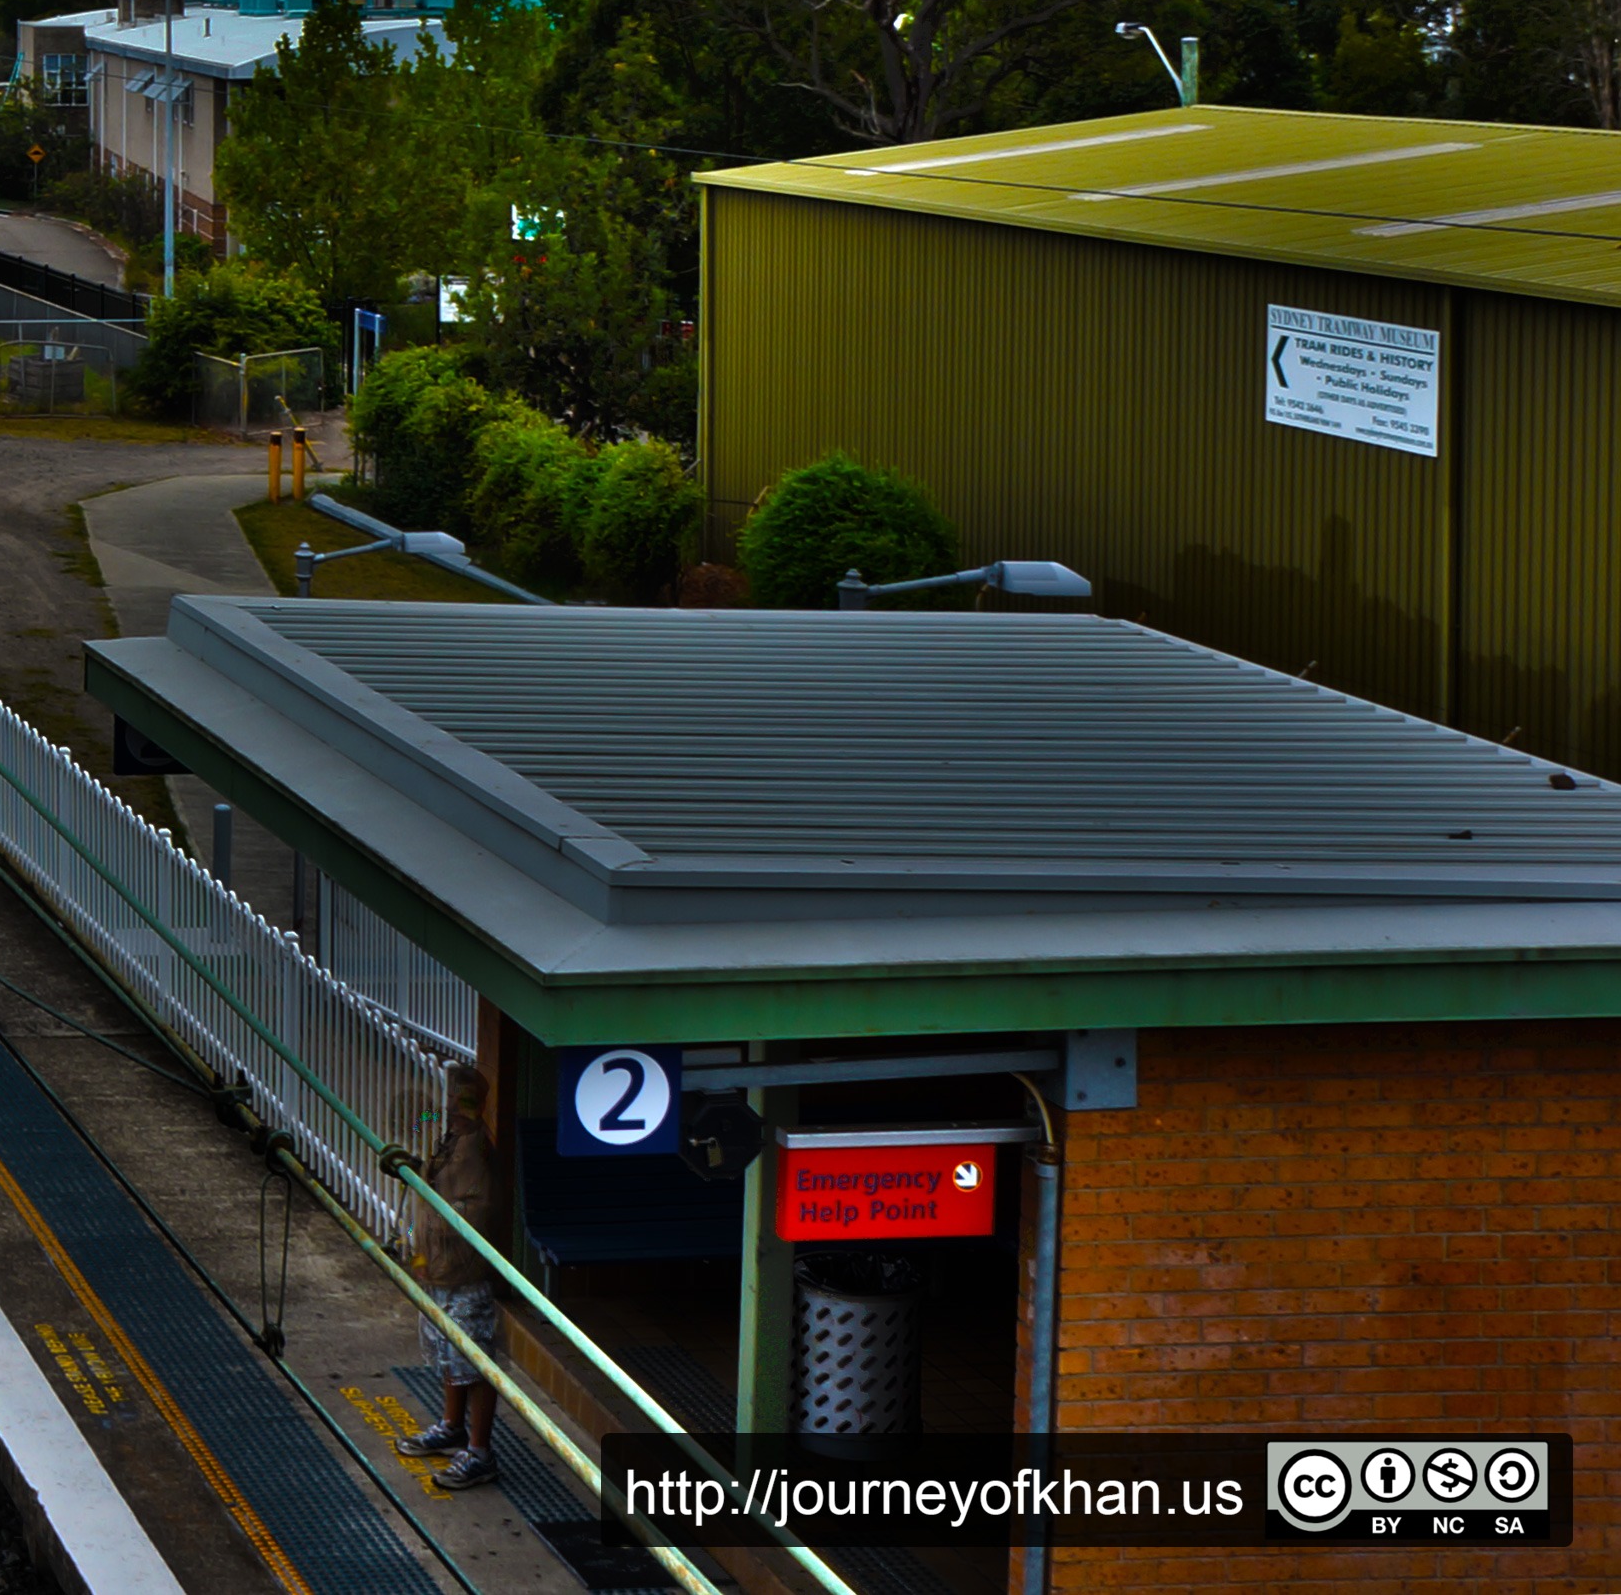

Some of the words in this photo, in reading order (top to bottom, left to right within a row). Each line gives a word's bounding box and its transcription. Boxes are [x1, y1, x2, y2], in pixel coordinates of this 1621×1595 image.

[1270, 308, 1314, 331] SYDNEY
[1317, 316, 1378, 340] TRAMWAY
[1380, 326, 1436, 350] MUSEUM
[1294, 337, 1327, 353] TRAM
[1330, 343, 1363, 360] RIDES
[1366, 350, 1376, 362] &
[1380, 352, 1434, 372] HISTORY
[1299, 355, 1367, 378] Wednesdays
[1380, 370, 1428, 390] Sundays
[1324, 375, 1358, 391] Public
[1360, 382, 1411, 402] Holidays
[599, 1057, 647, 1132] 2
[796, 1168, 942, 1196] Emergency
[799, 1199, 859, 1226] Help
[869, 1198, 939, 1222] Point
